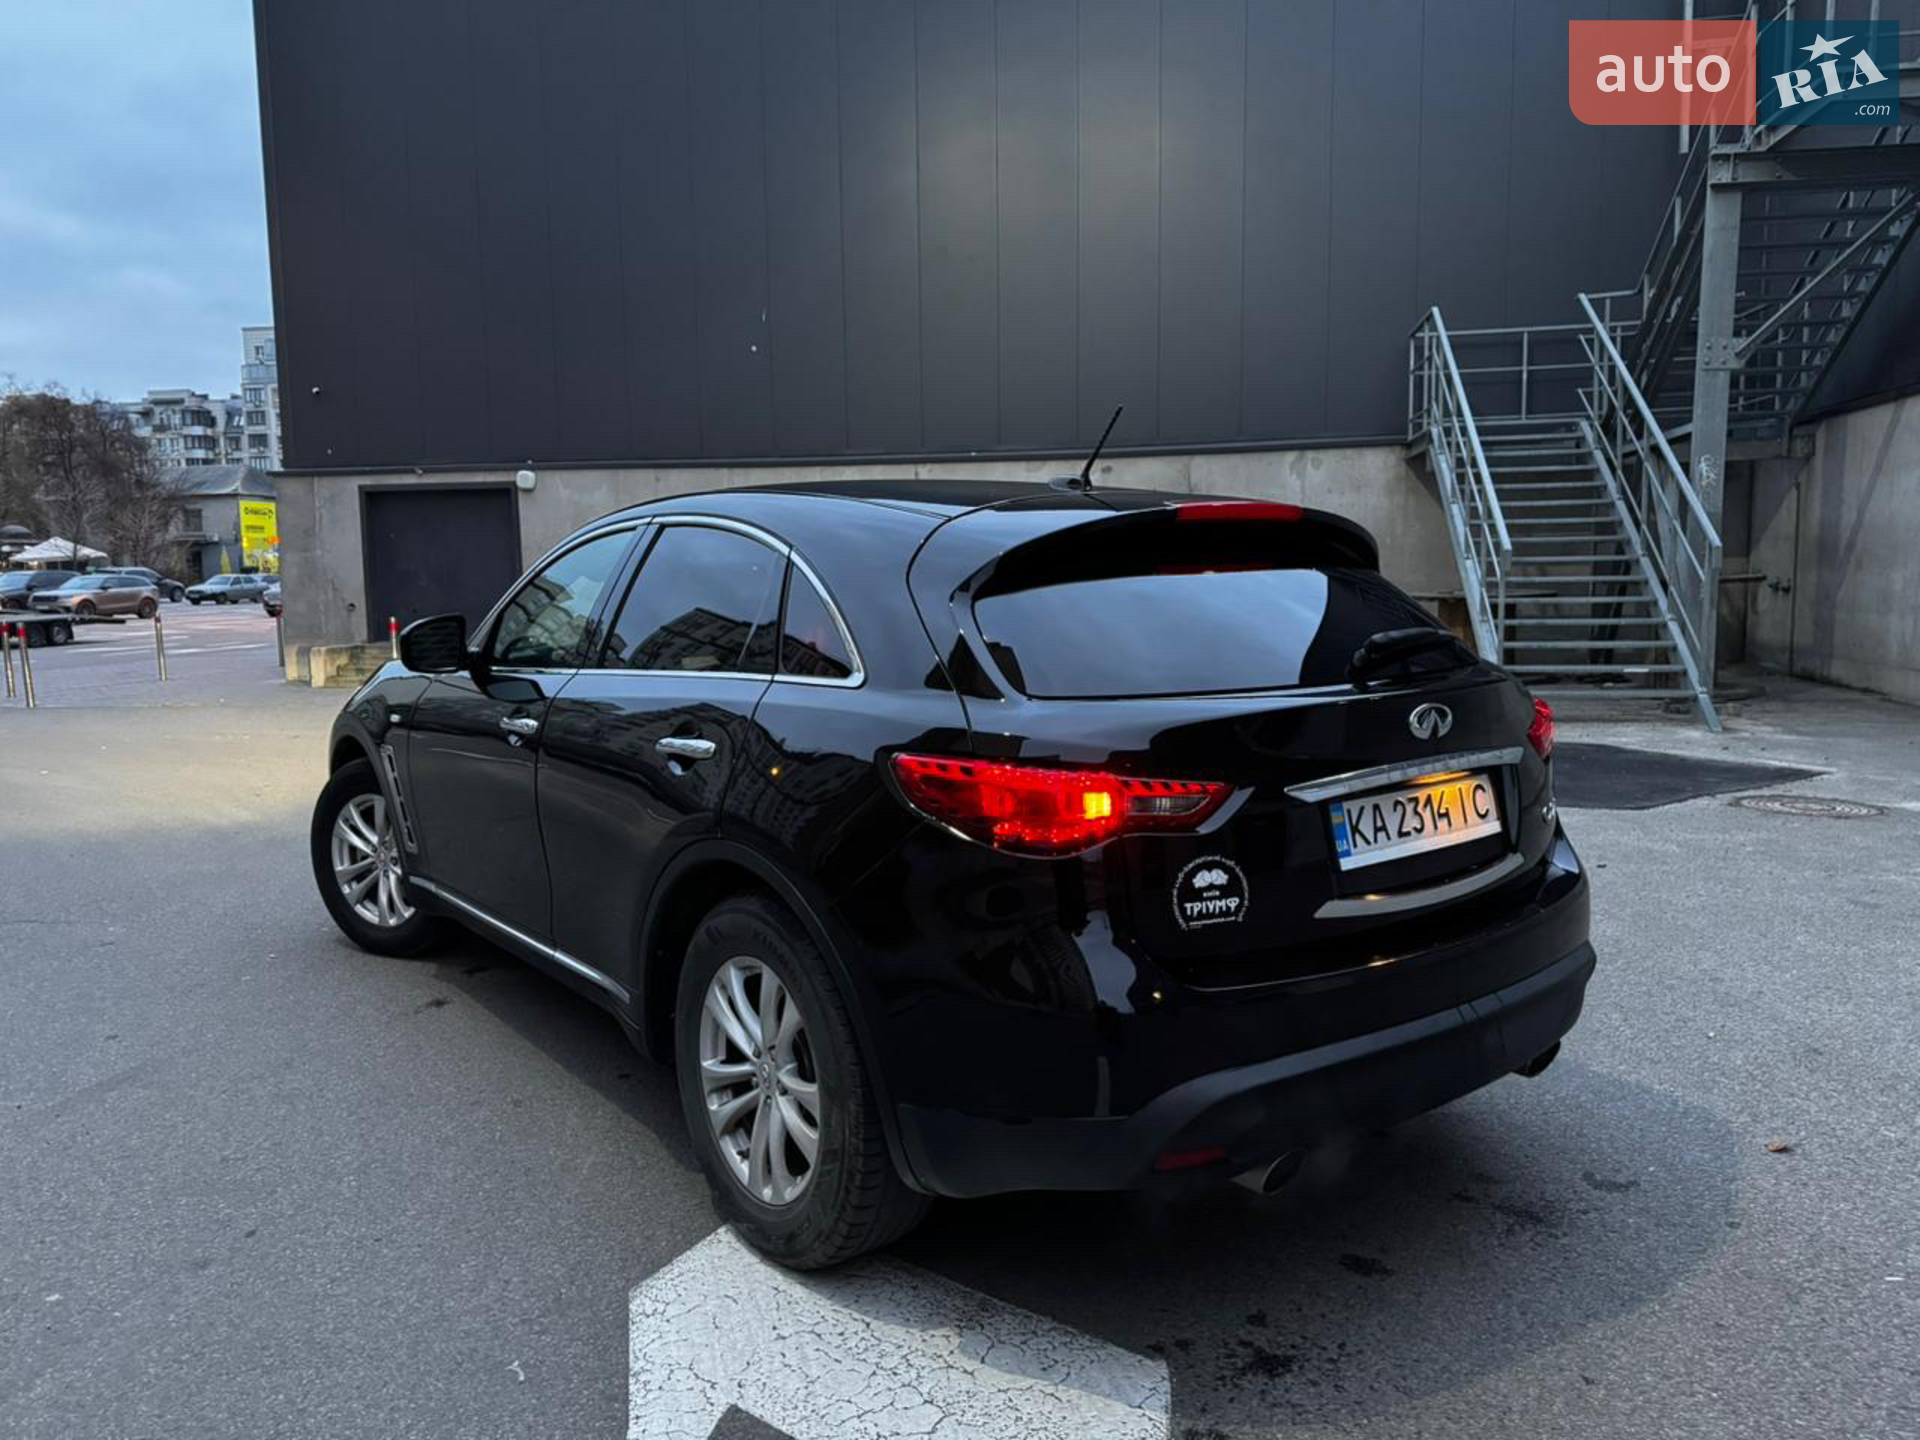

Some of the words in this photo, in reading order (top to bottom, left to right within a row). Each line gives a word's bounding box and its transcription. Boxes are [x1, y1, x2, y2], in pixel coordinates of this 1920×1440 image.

[1346, 803, 1392, 849] KA
[1393, 790, 1453, 839] 2314
[1458, 783, 1491, 827] IC
[1335, 840, 1350, 853] UA
